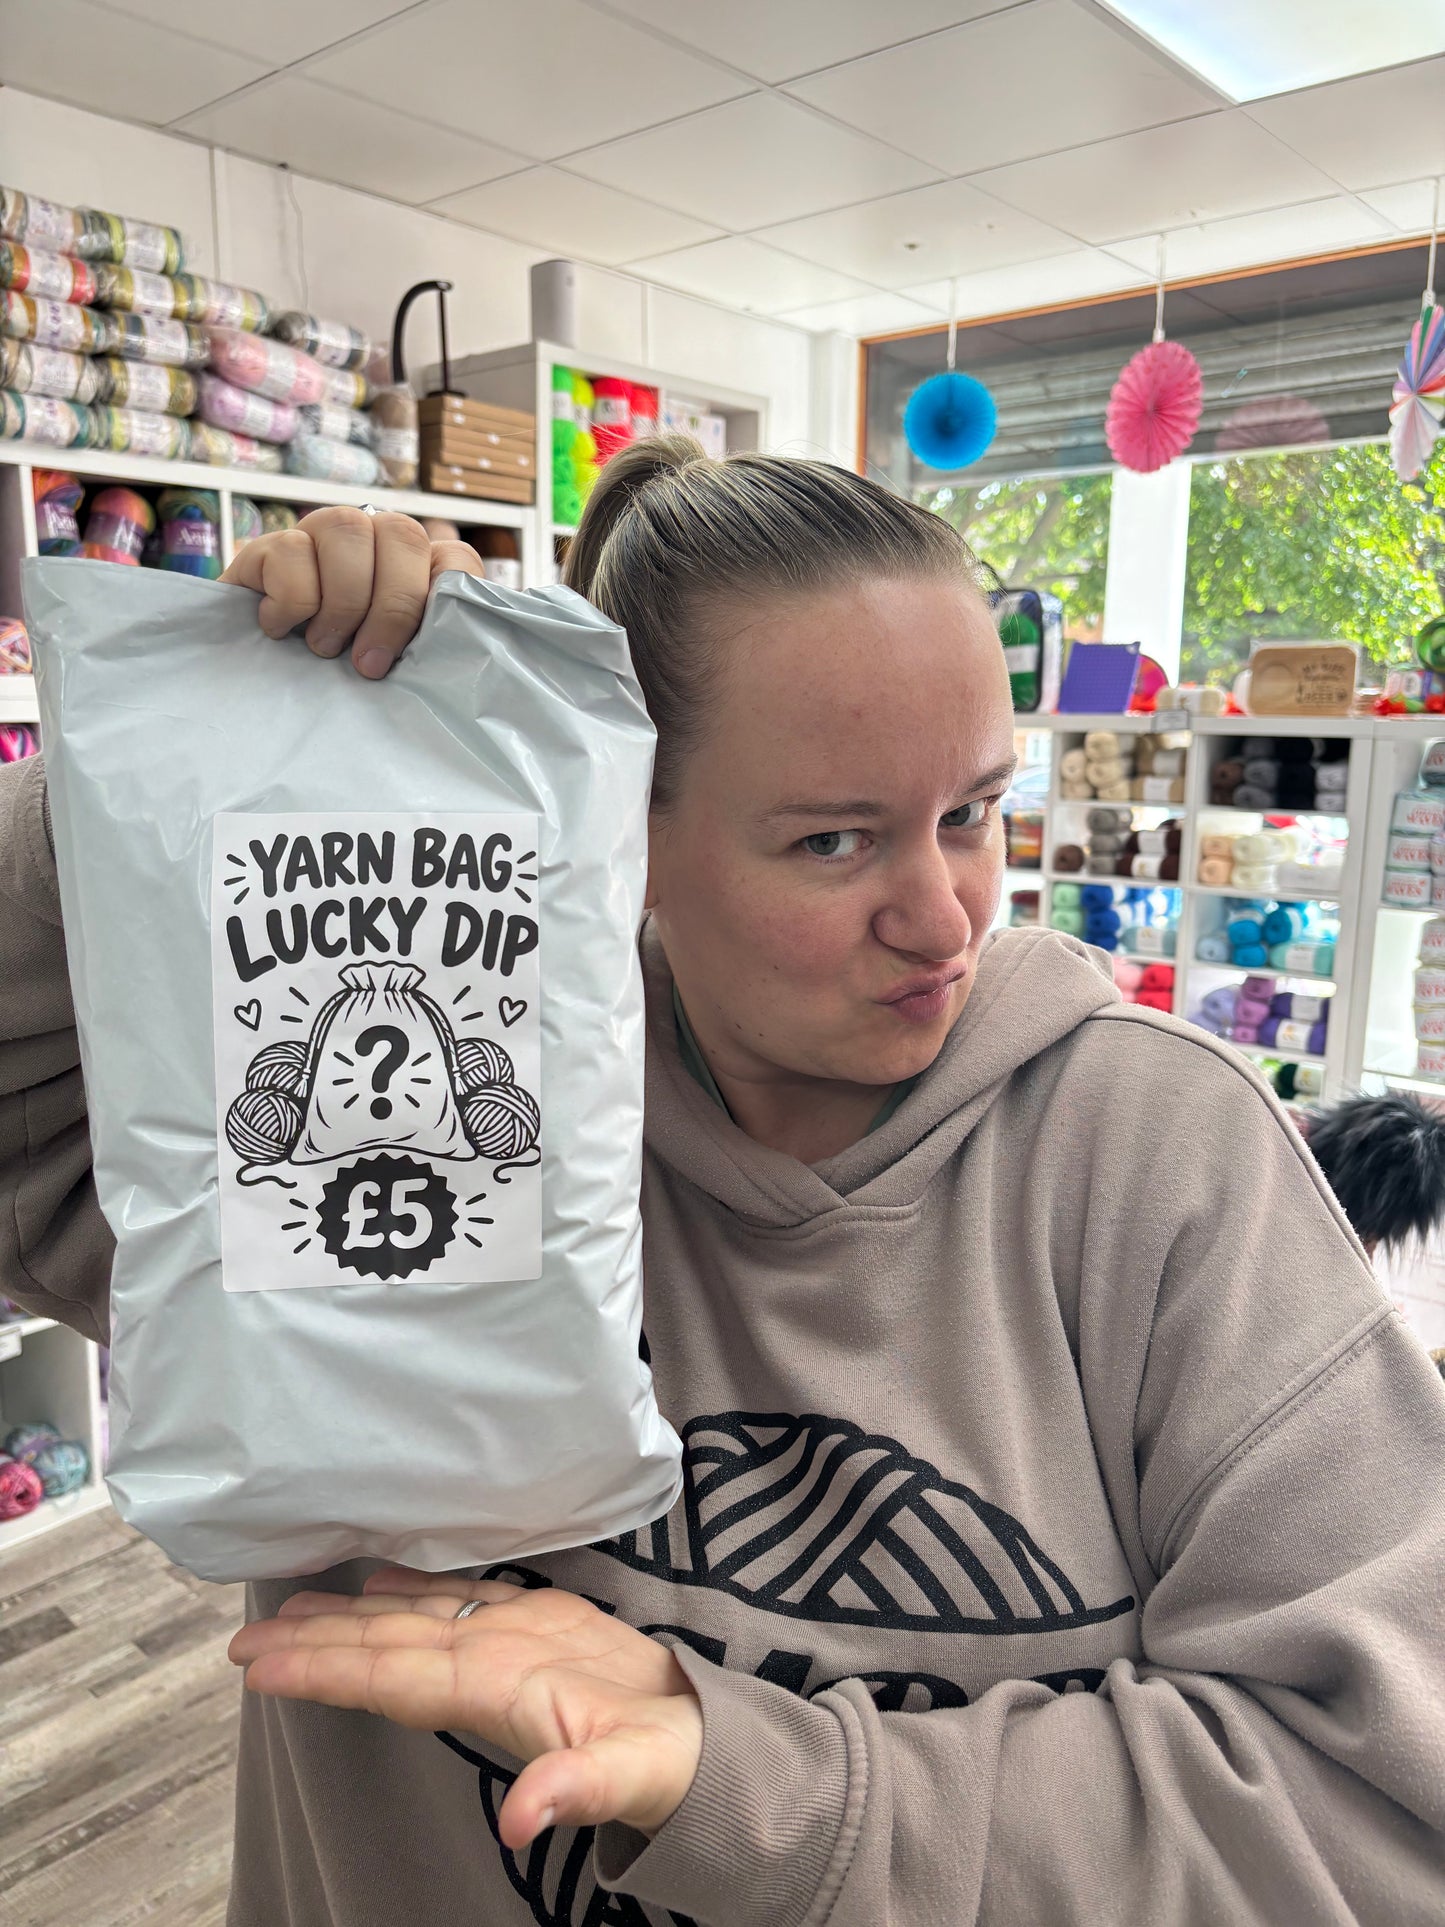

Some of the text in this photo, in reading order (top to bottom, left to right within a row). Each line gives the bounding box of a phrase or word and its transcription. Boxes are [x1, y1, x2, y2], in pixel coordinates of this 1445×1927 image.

[249, 828, 512, 897] YARN BAG
[226, 897, 539, 982] LUCKY DIP
[355, 1025, 410, 1120] ?
[342, 1179, 433, 1250] £5
